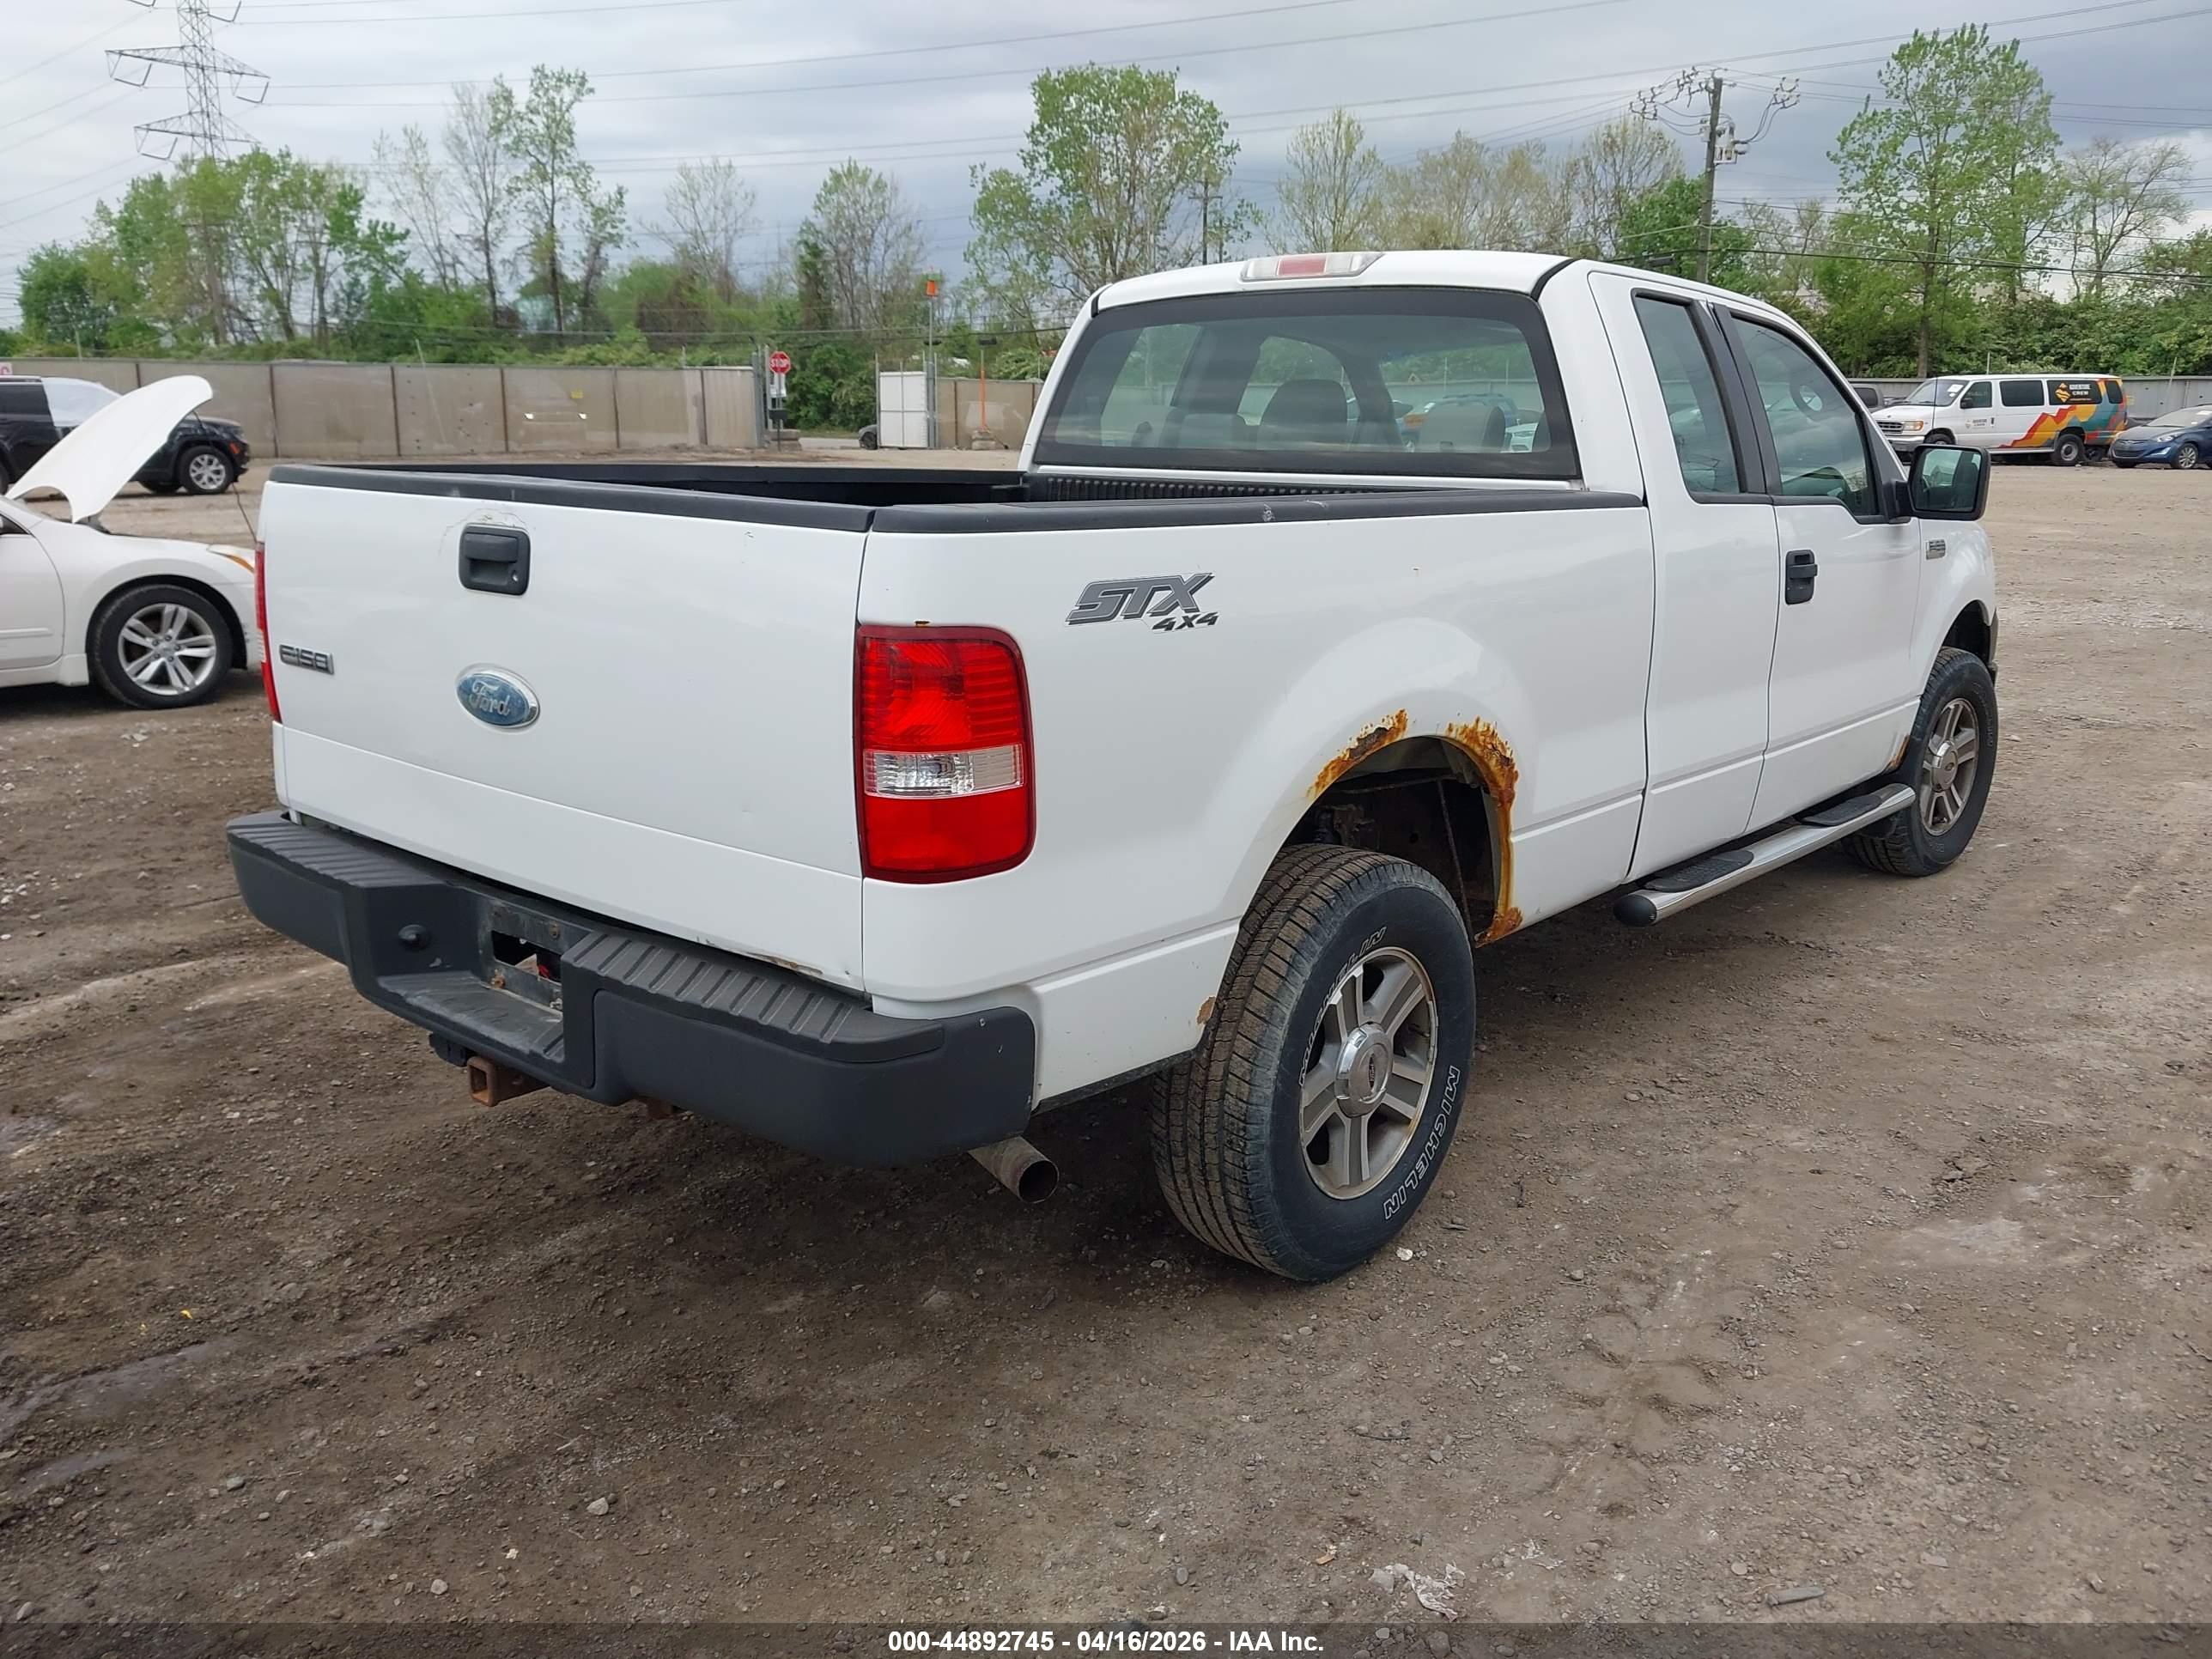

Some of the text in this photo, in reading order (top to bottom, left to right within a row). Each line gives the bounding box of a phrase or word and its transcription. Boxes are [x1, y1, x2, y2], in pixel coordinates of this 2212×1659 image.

[770, 358, 790, 368] STOP
[1065, 572, 1215, 625] STX
[470, 680, 511, 716] Ford
[1383, 1065, 1460, 1220] MICHELIN
